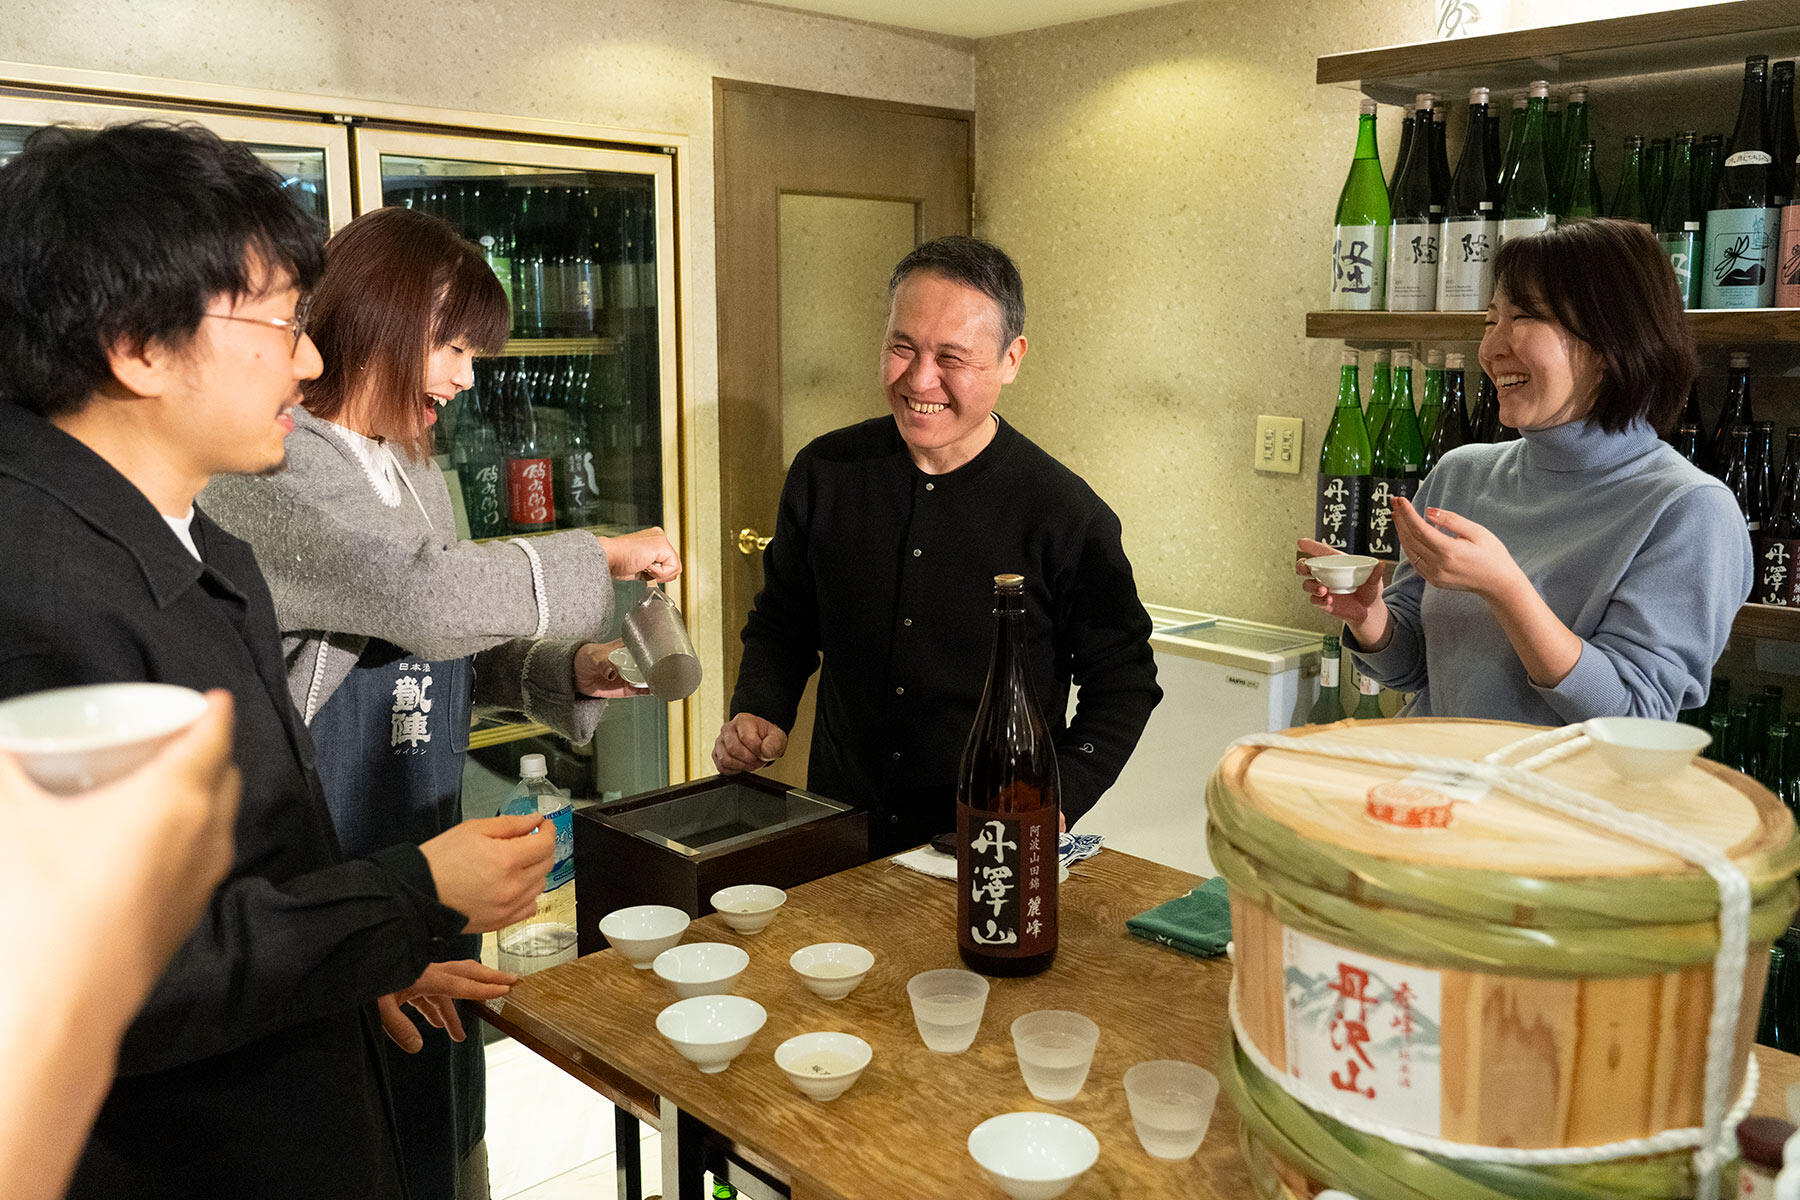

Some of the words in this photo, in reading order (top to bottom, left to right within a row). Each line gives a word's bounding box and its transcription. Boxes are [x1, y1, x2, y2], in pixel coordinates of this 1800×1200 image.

[1333, 240, 1373, 293] 隆
[1411, 235, 1437, 264] 隆
[1461, 233, 1489, 262] 隆
[1762, 543, 1790, 605] 丹澤山
[970, 820, 1017, 945] 丹澤山
[1029, 824, 1041, 890] 阿波山田錦
[1026, 895, 1043, 939] 麗峰
[1328, 962, 1376, 1099] 丹沢山
